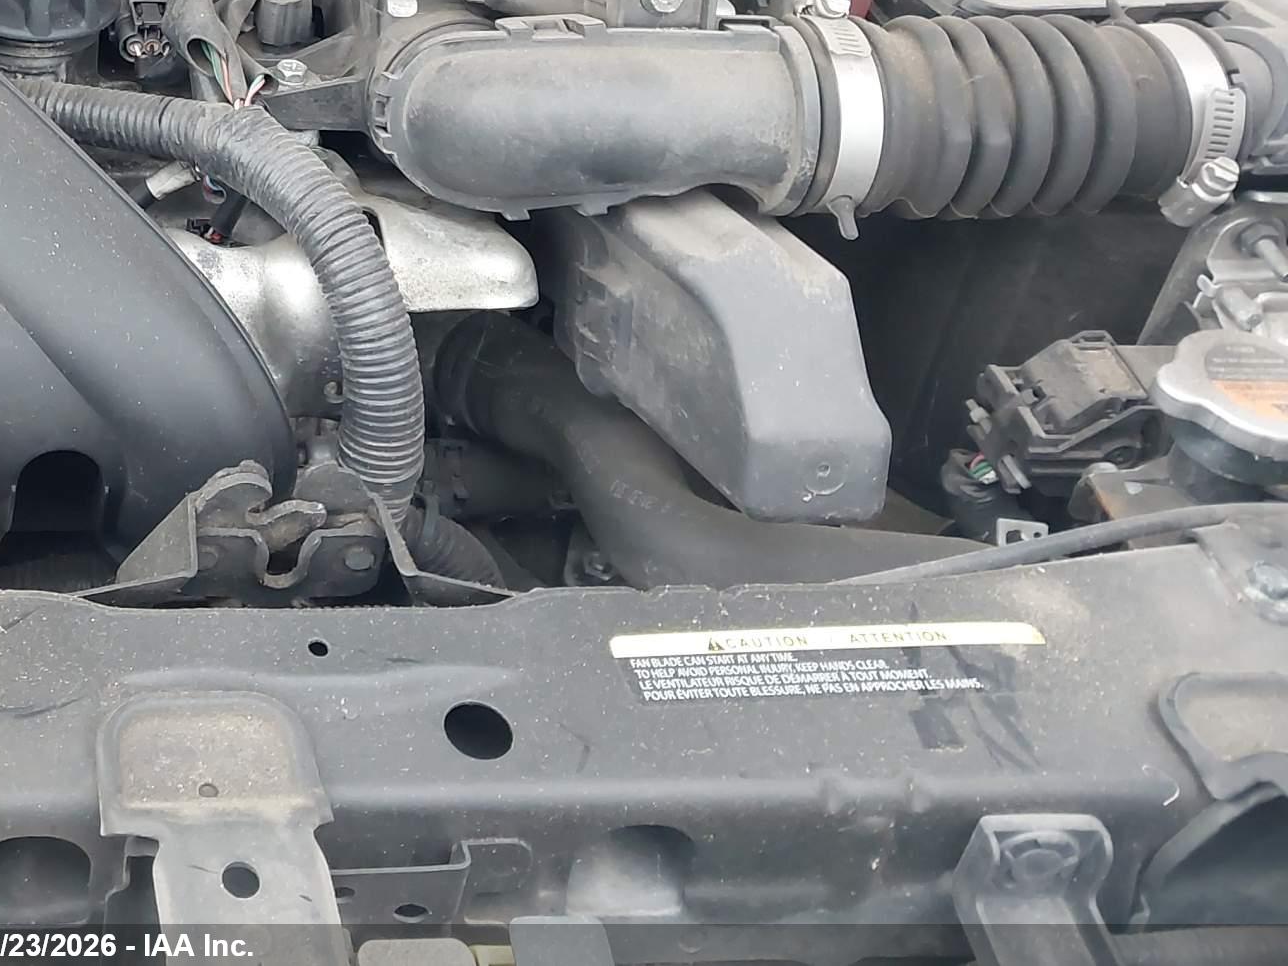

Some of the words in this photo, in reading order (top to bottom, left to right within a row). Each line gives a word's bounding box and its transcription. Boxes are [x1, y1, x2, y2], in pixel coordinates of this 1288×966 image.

[725, 636, 808, 651] CAUTION
[850, 631, 947, 645] ATTENTION
[630, 658, 651, 669] FAN
[651, 657, 682, 668] BLADE
[684, 655, 706, 666] CAN
[707, 654, 735, 665] START
[737, 654, 748, 664] AT
[634, 669, 649, 680] TO
[651, 668, 675, 679] HELP
[677, 667, 707, 678] AVOID
[710, 665, 759, 677] PERSONAL
[796, 662, 819, 672] KEEP
[820, 660, 856, 671] HANDS
[856, 659, 889, 670] CLEAR.
[639, 680, 655, 691] LE
[655, 677, 724, 690] VENTILATEUR
[725, 675, 765, 687] RISQUE
[766, 674, 781, 684] DE
[851, 670, 878, 681] TOUT
[880, 668, 932, 680] MOMENT.
[644, 690, 676, 702] POUR
[714, 687, 749, 698] TOUTE
[806, 685, 823, 695] NE
[824, 684, 844, 694] PAS
[846, 683, 860, 693] EN
[861, 680, 927, 693] APPROCHER
[928, 679, 945, 690] LES
